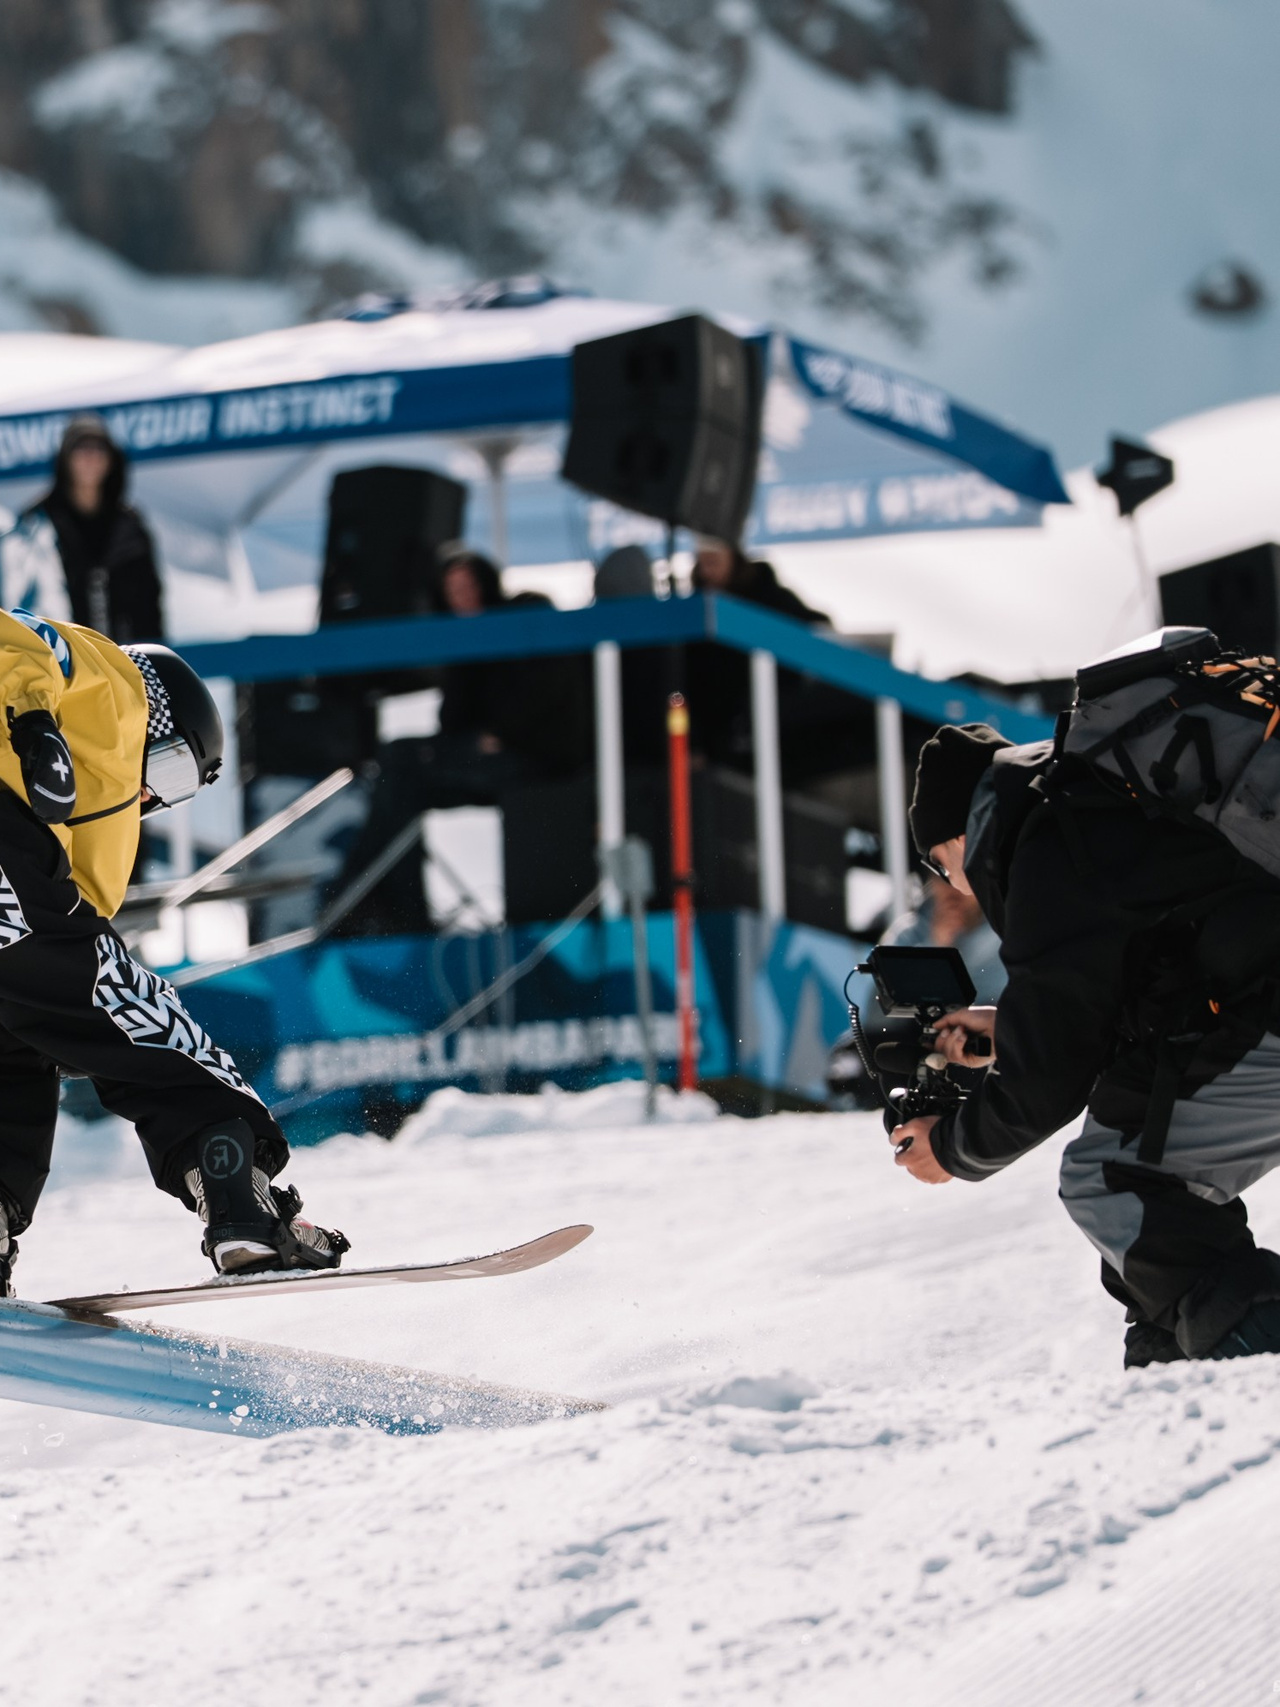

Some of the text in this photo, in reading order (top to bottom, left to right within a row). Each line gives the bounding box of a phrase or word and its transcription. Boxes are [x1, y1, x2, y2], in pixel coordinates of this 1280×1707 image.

[111, 398, 211, 450] YOUR
[220, 375, 404, 440] INSTINCT
[212, 1227, 235, 1237] RIDE
